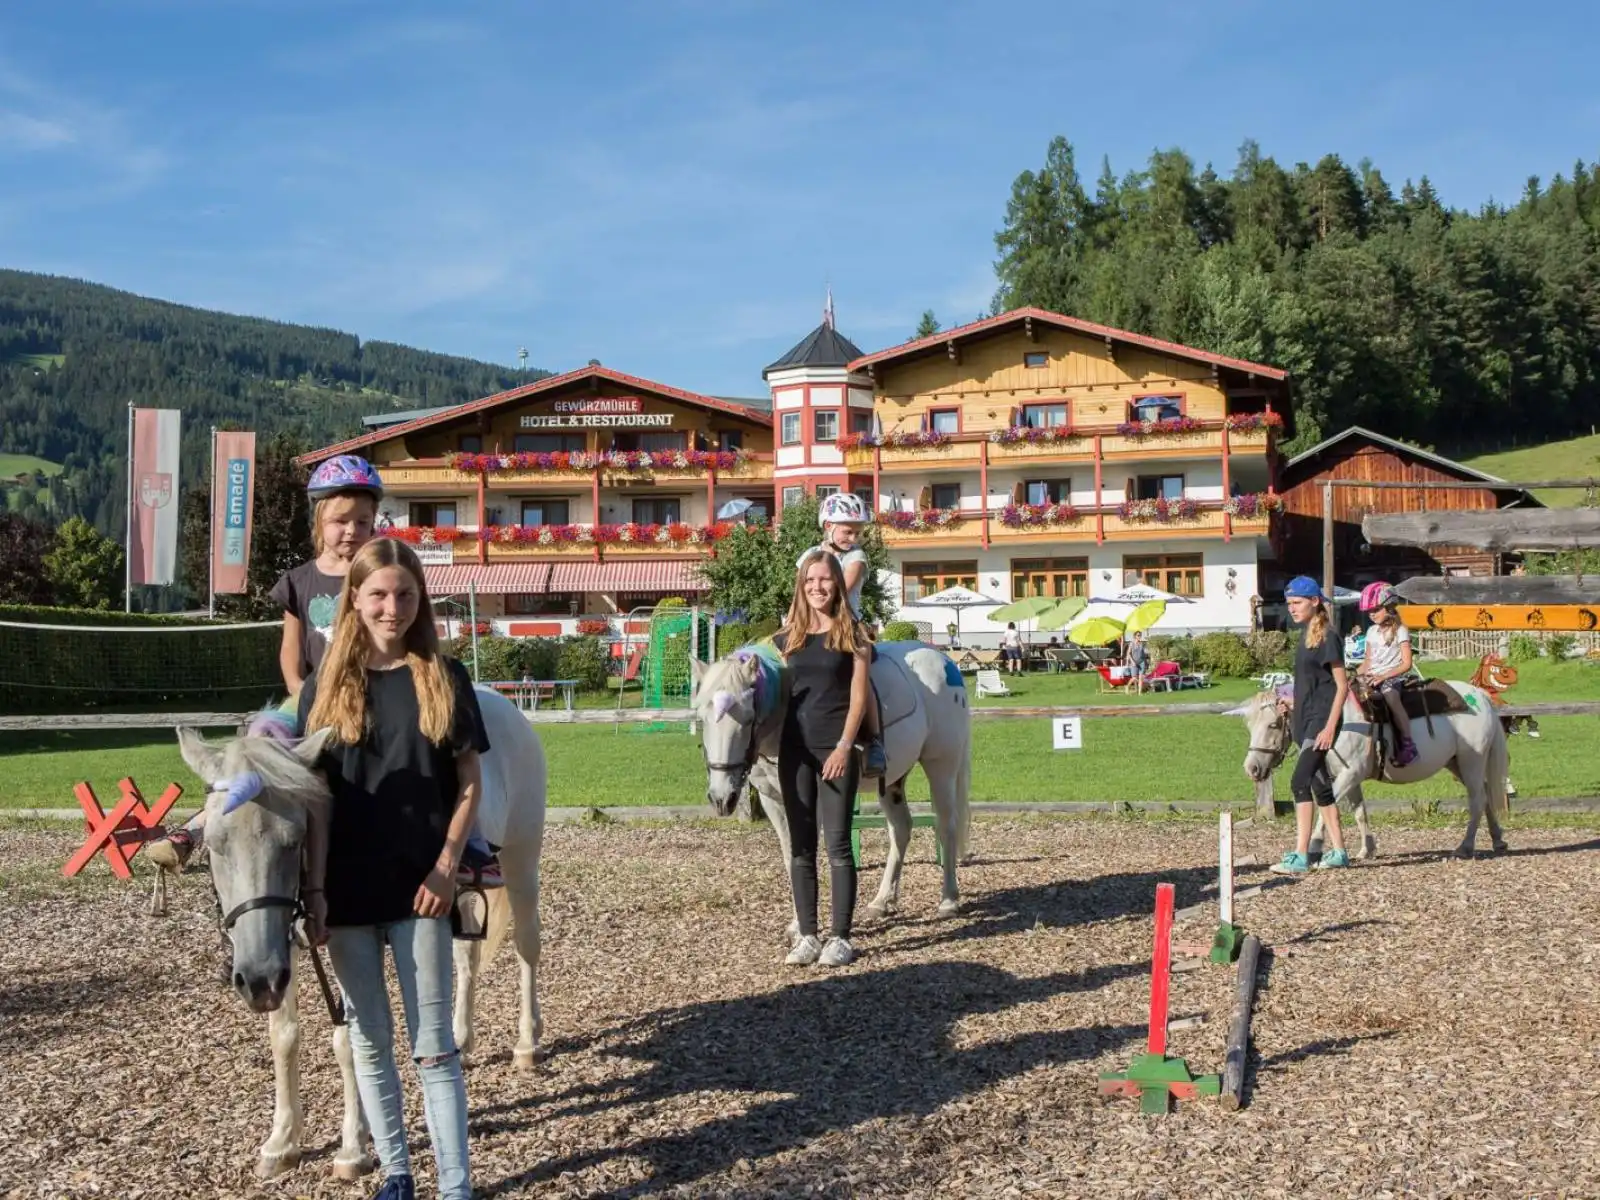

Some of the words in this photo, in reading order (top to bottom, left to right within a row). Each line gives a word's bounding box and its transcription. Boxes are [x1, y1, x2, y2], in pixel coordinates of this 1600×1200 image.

[554, 398, 638, 412] GEWÜRZMÜHLE
[520, 415, 565, 428] HOTEL
[568, 415, 579, 427] &
[582, 414, 674, 426] RESTAURANT
[1063, 723, 1073, 739] E
